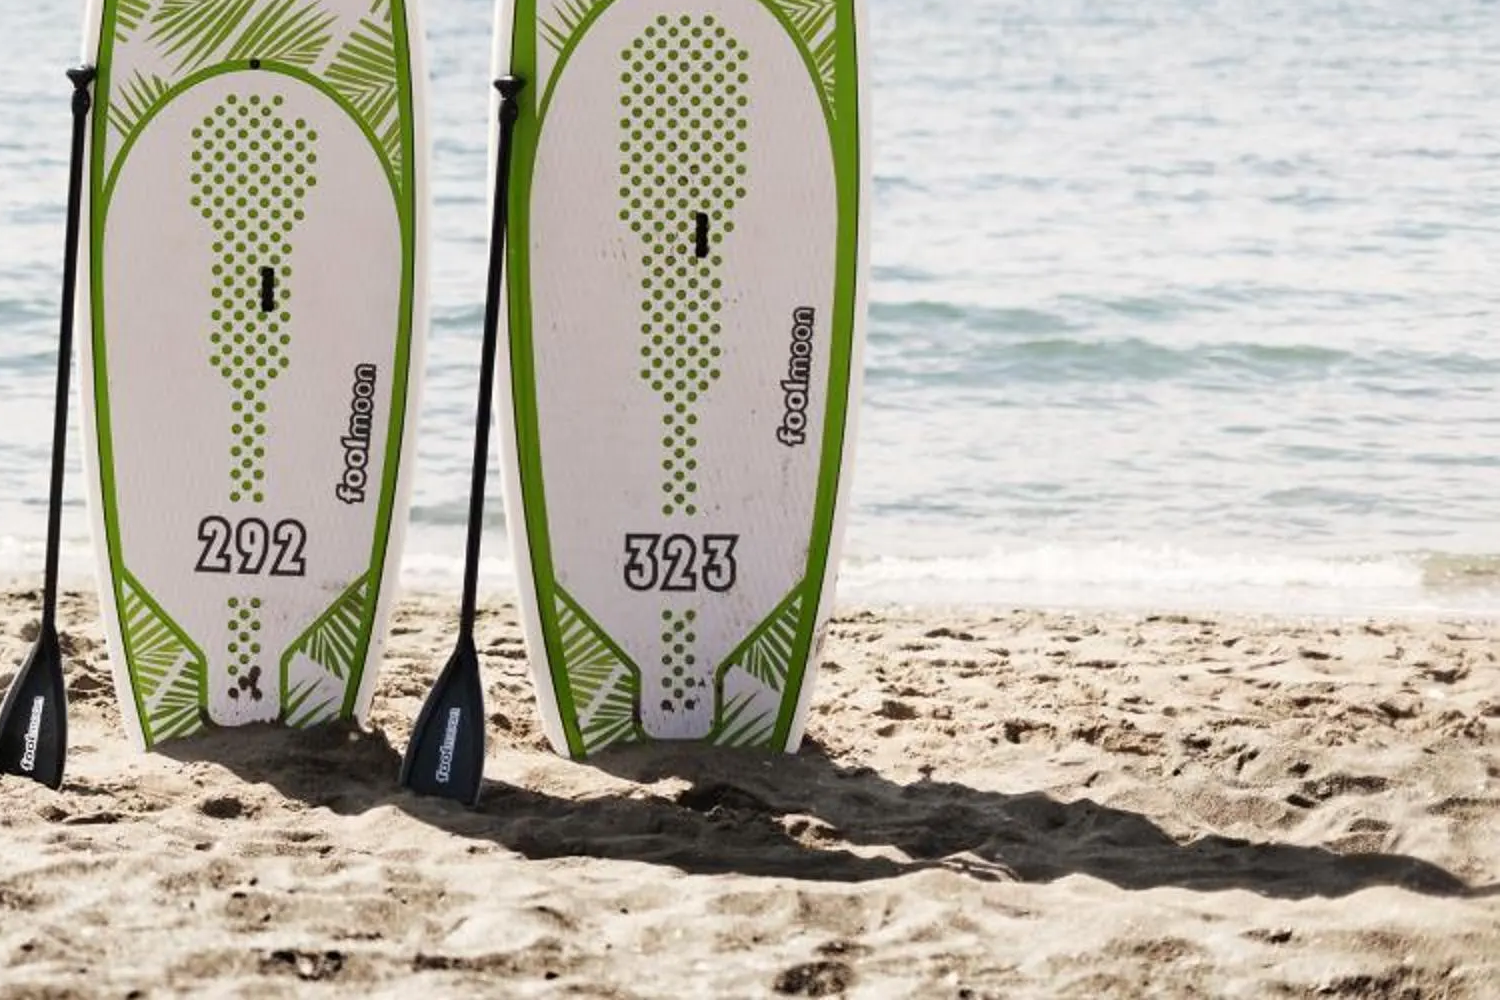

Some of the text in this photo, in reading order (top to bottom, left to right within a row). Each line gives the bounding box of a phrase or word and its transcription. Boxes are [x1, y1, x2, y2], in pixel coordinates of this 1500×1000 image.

[776, 306, 816, 448] foolmoon
[335, 363, 377, 504] foolmoon
[194, 514, 307, 577] 292
[623, 533, 740, 593] 323
